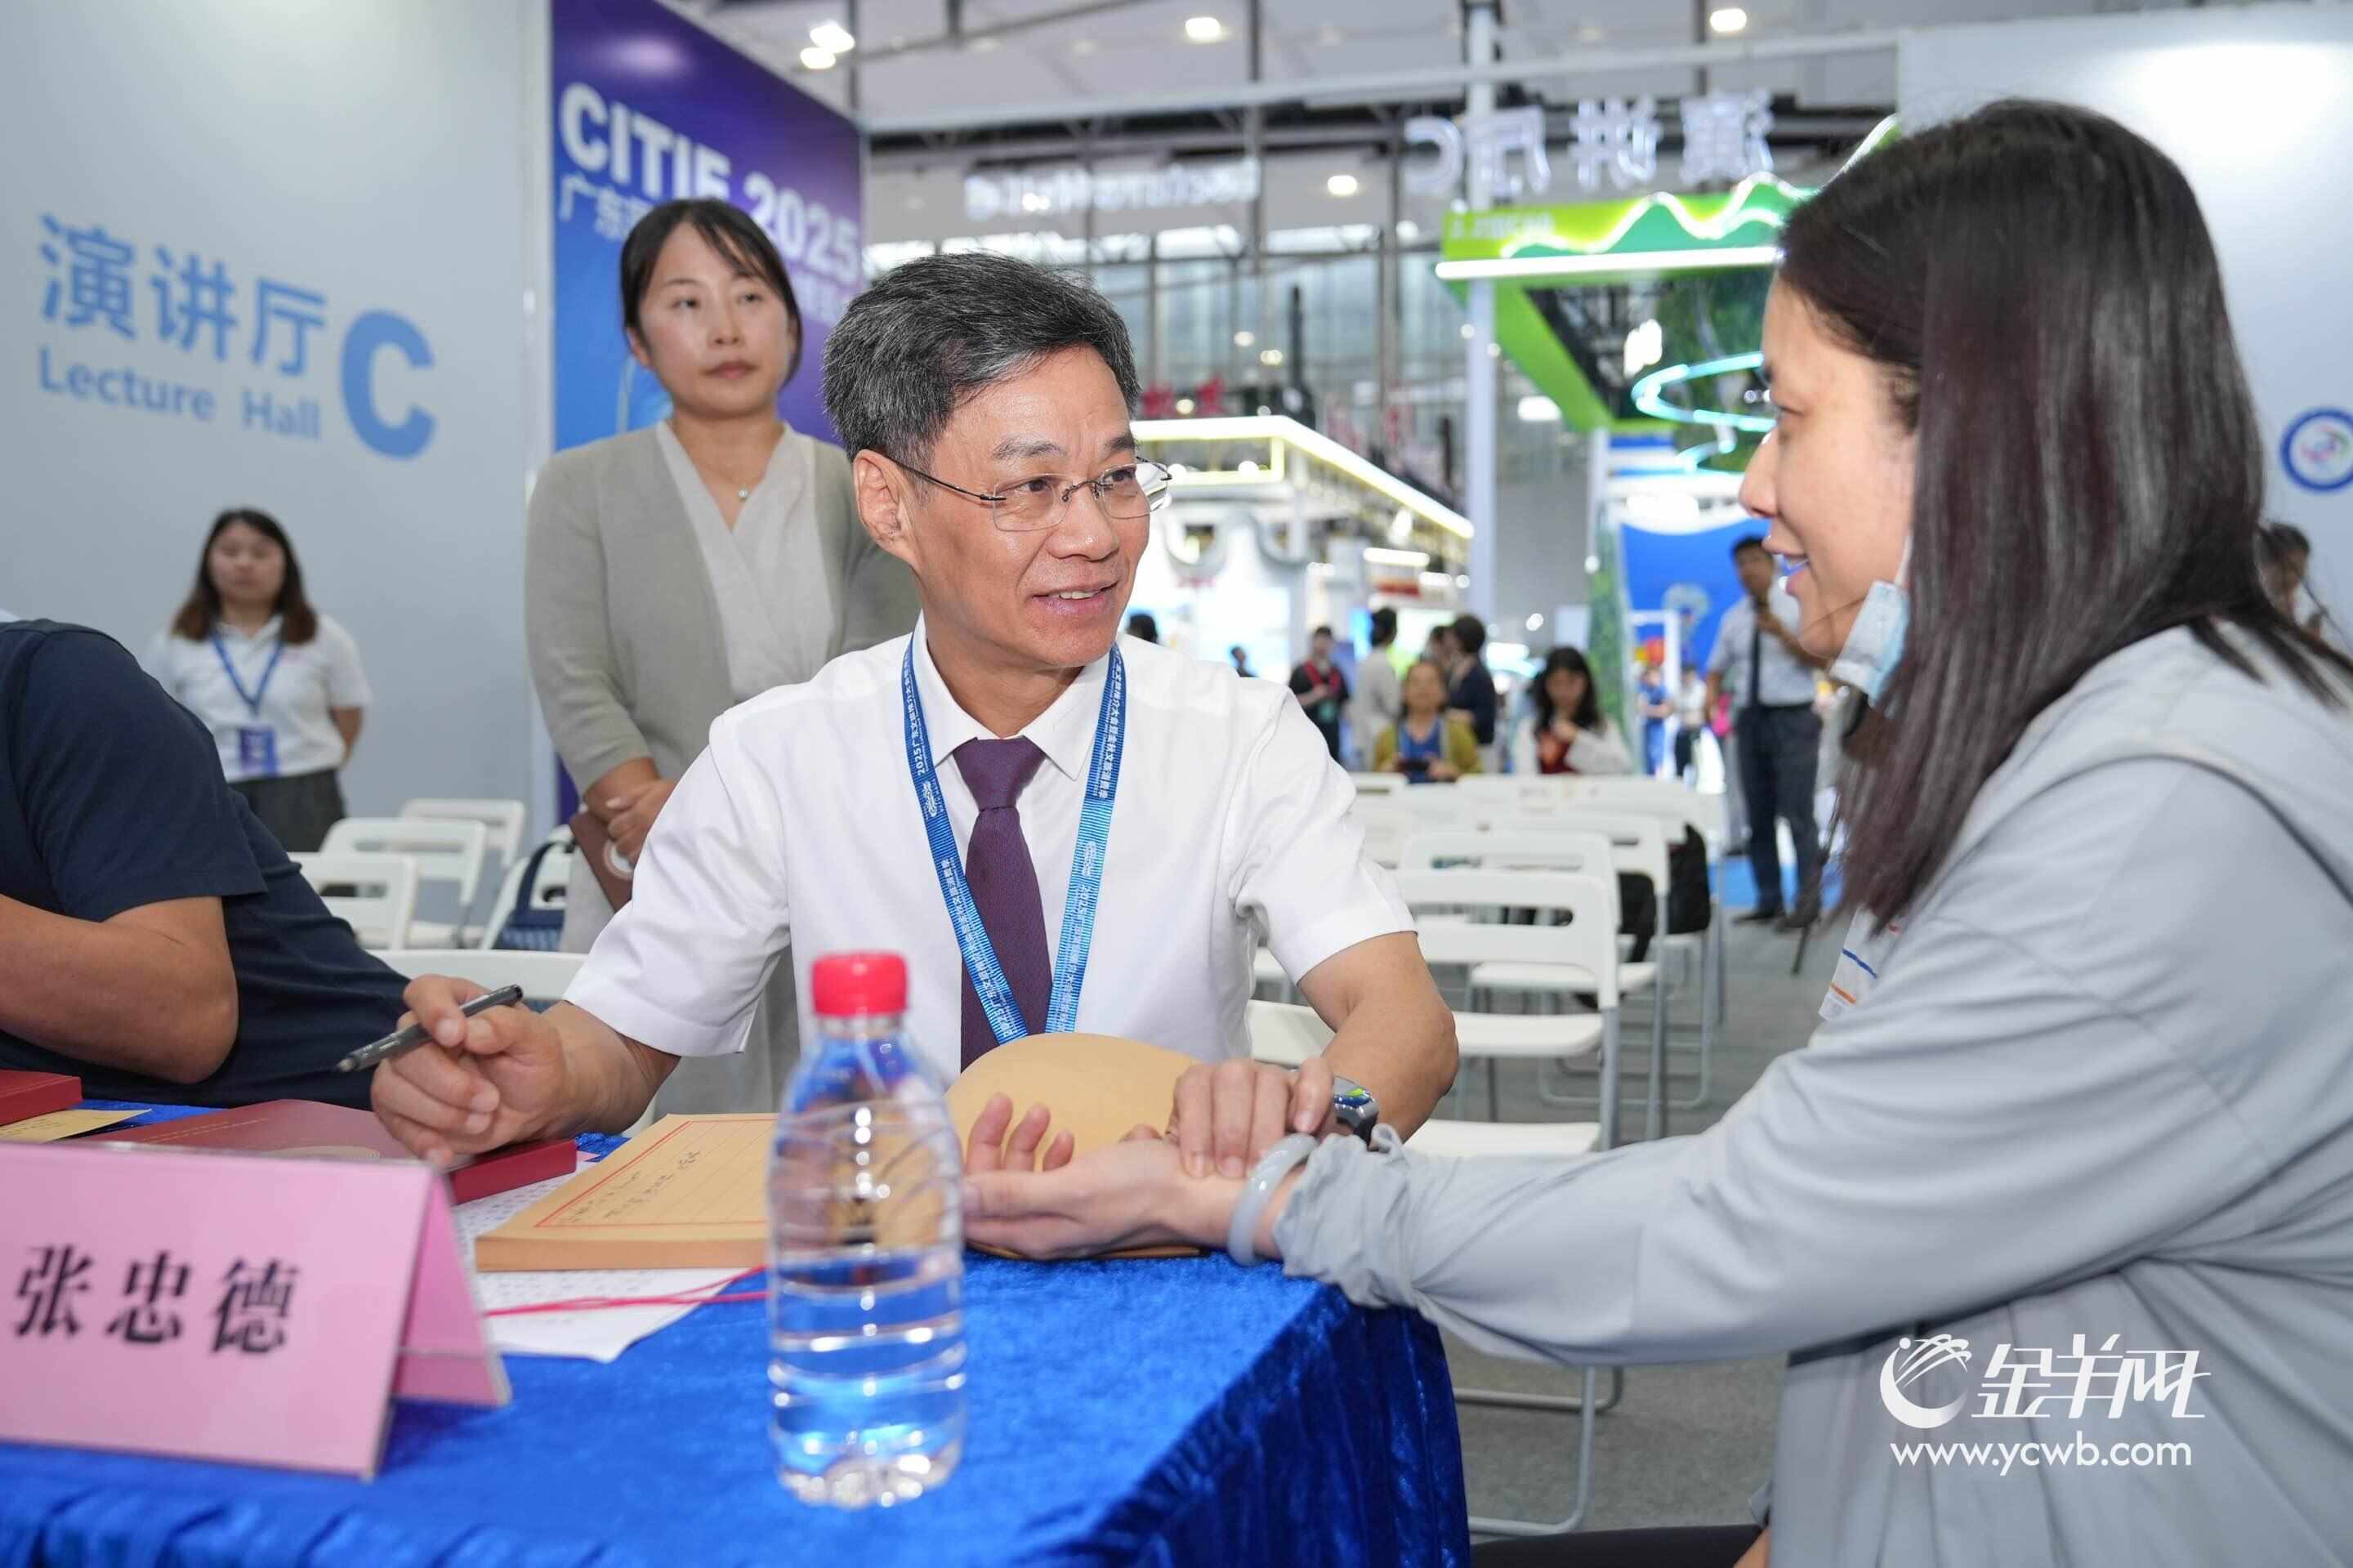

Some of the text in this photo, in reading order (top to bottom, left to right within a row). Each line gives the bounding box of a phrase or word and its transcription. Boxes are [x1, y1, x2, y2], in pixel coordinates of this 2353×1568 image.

[743, 170, 859, 284] 2025
[38, 212, 435, 459] 演讲厅 C
[38, 346, 321, 440] Lecture Hall
[16, 1244, 301, 1354] 张忠德
